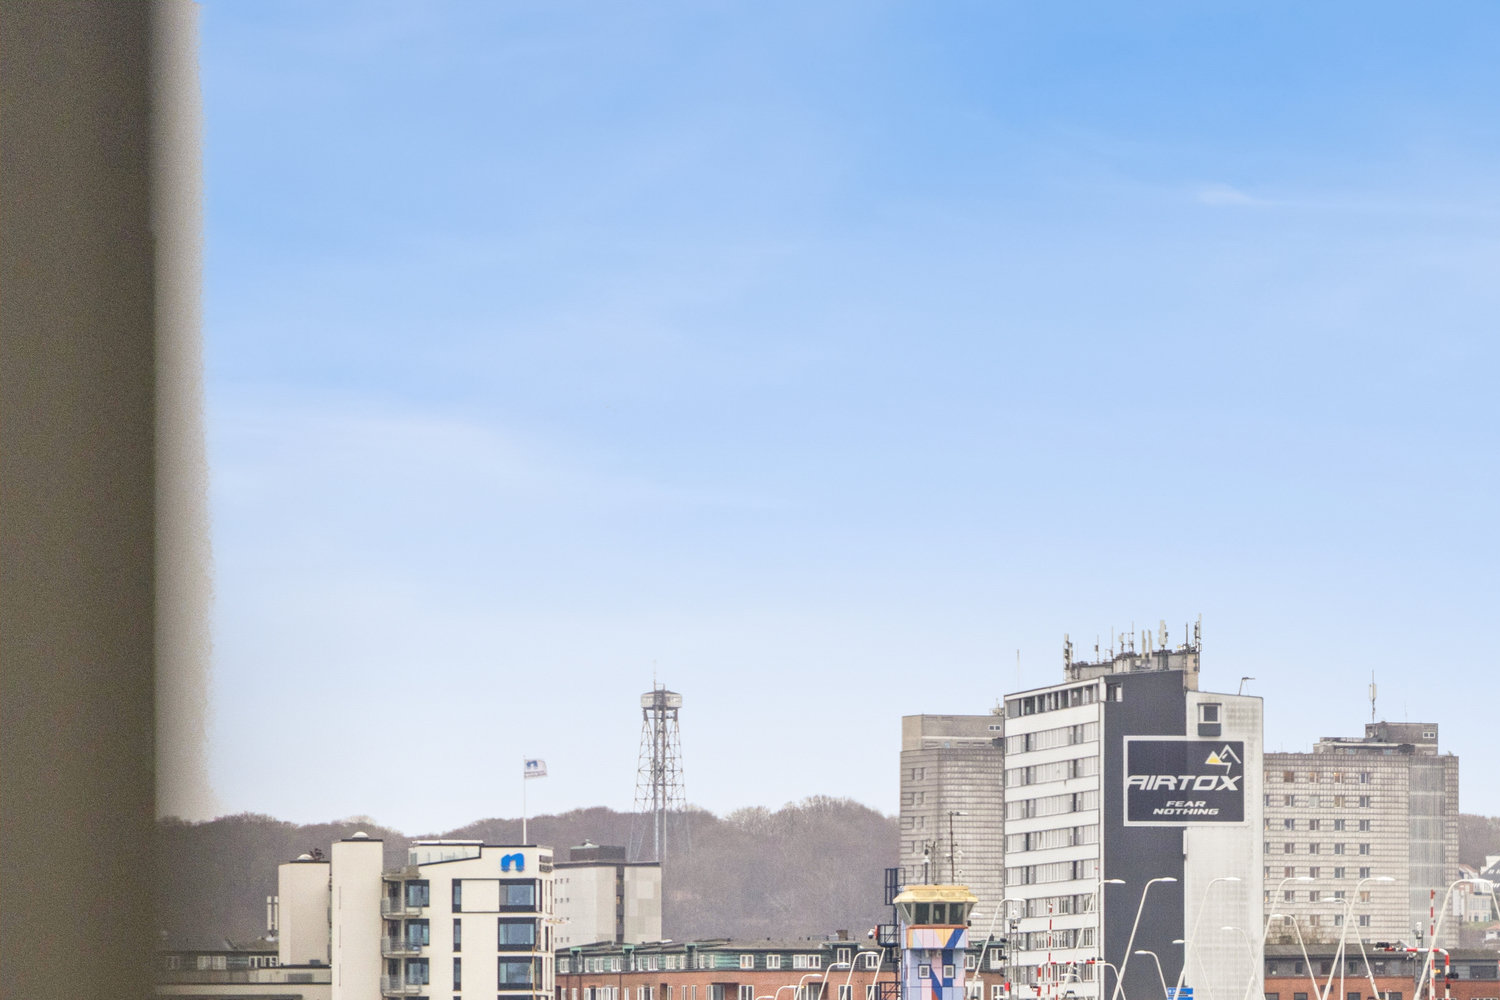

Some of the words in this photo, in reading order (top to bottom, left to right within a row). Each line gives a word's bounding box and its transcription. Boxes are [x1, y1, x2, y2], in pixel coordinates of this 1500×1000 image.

[1127, 775, 1242, 791] AIRTOX
[1166, 800, 1206, 808] FEAR
[1153, 808, 1220, 816] NOTHING
